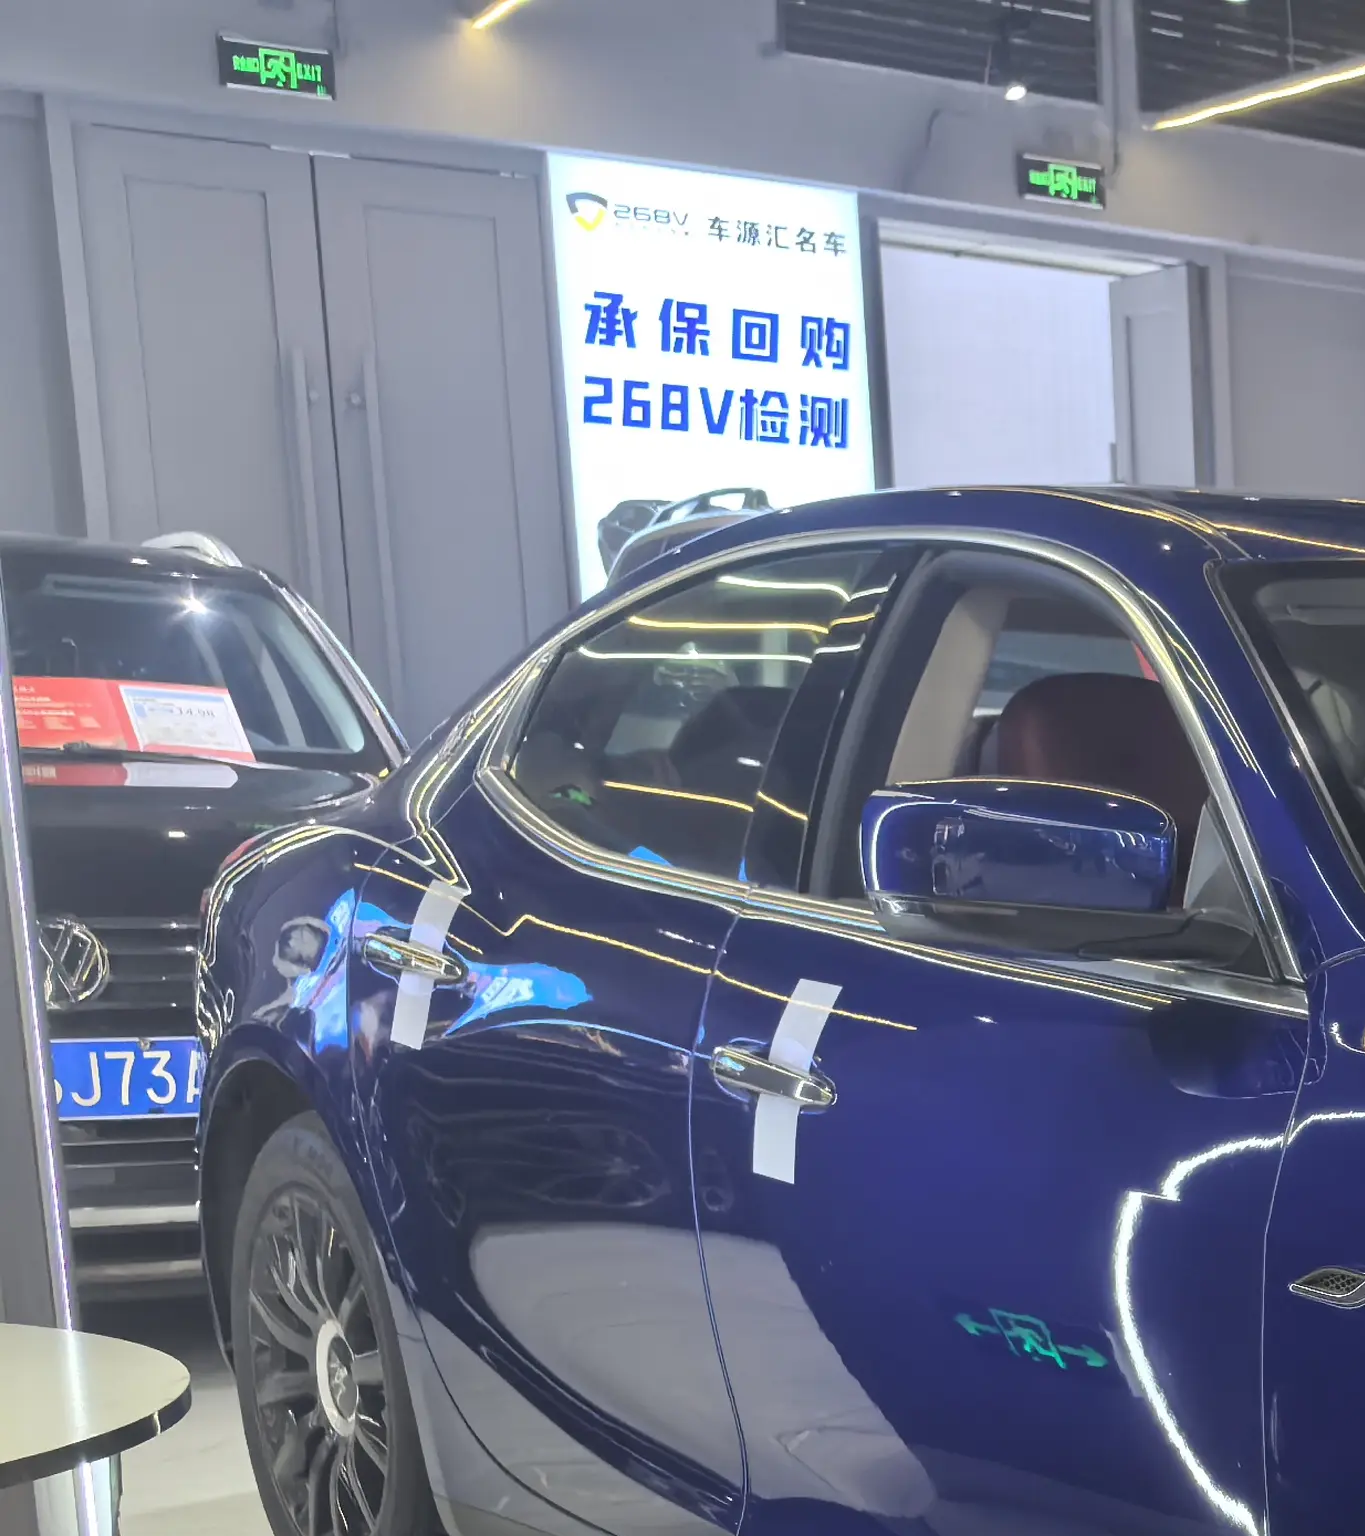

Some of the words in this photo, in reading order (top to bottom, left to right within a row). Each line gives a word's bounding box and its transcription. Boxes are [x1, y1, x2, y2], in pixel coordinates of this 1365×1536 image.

[613, 203, 689, 226] 268V
[707, 215, 846, 257] 车源汇名车
[584, 290, 850, 371] 承保回购
[583, 375, 850, 450] 268V检测
[53, 1050, 201, 1107] J73
